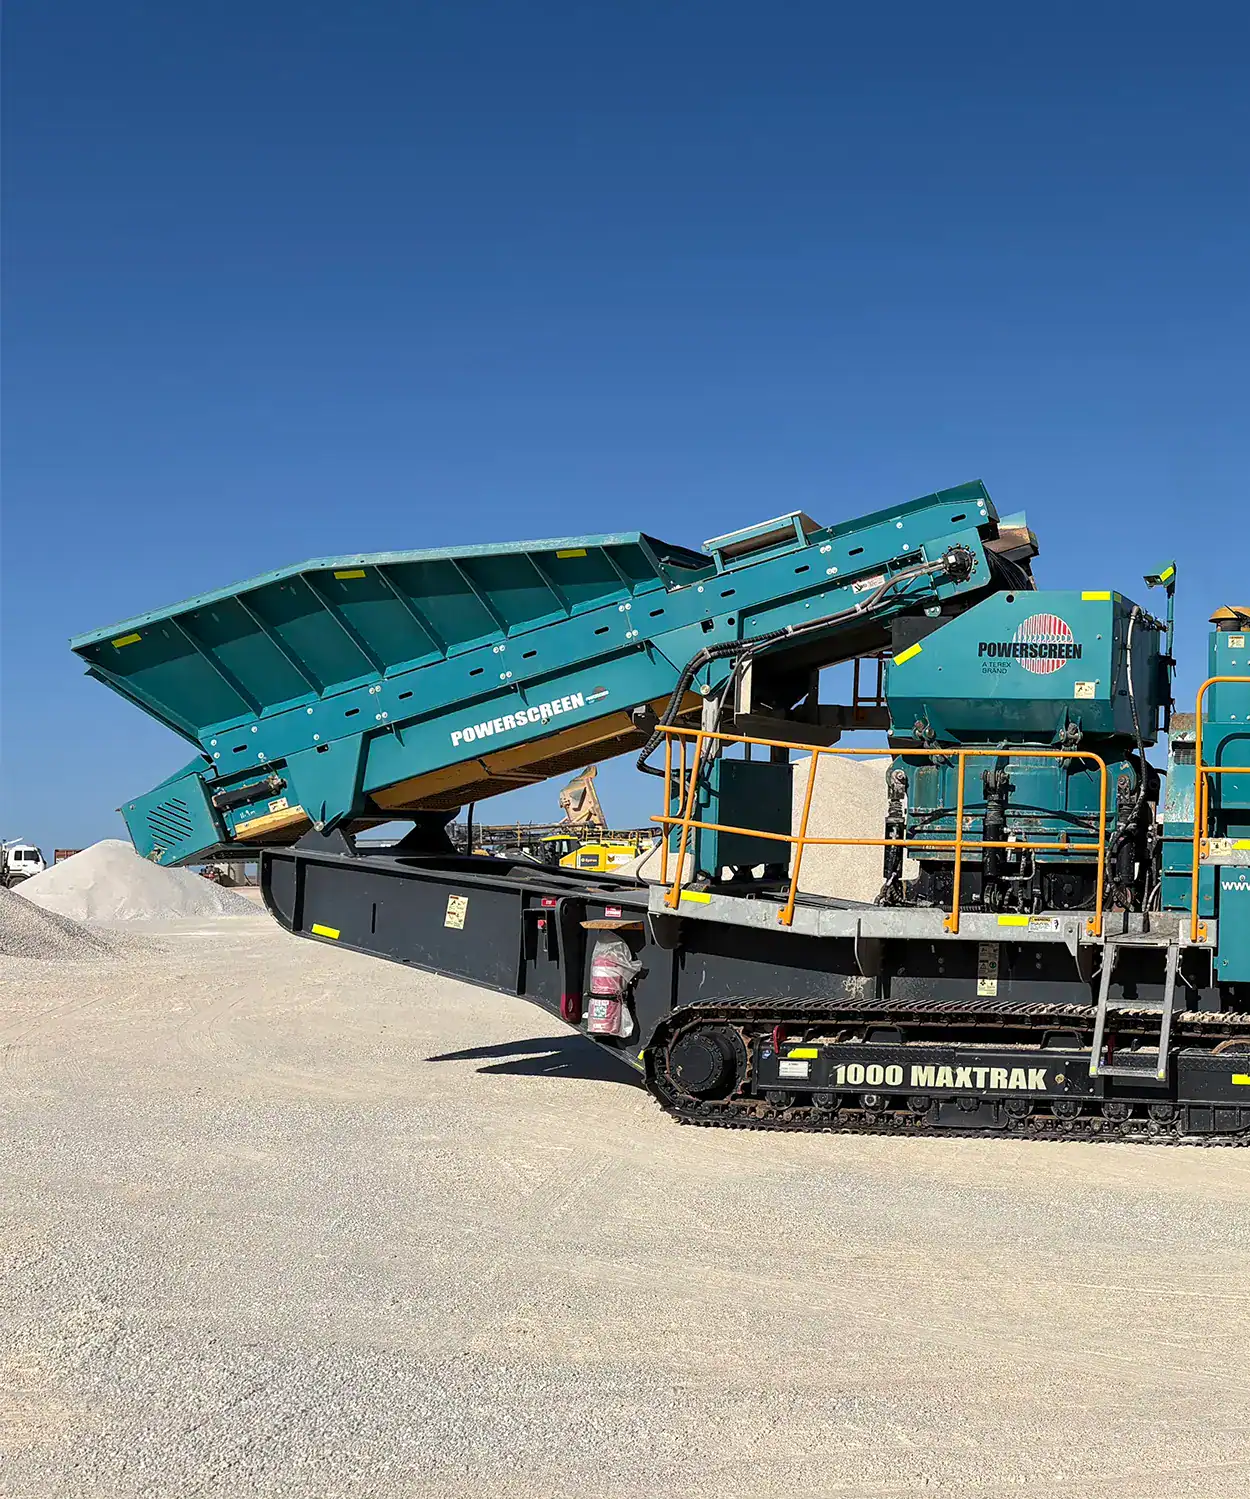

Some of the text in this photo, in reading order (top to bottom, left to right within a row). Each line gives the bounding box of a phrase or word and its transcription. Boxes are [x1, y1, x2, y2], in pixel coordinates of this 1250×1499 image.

[978, 642, 1082, 659] POWERSCREEN
[450, 692, 585, 747] POWERSCREEN
[831, 1063, 903, 1086] 1000
[910, 1065, 1047, 1090] MAXTRAK
